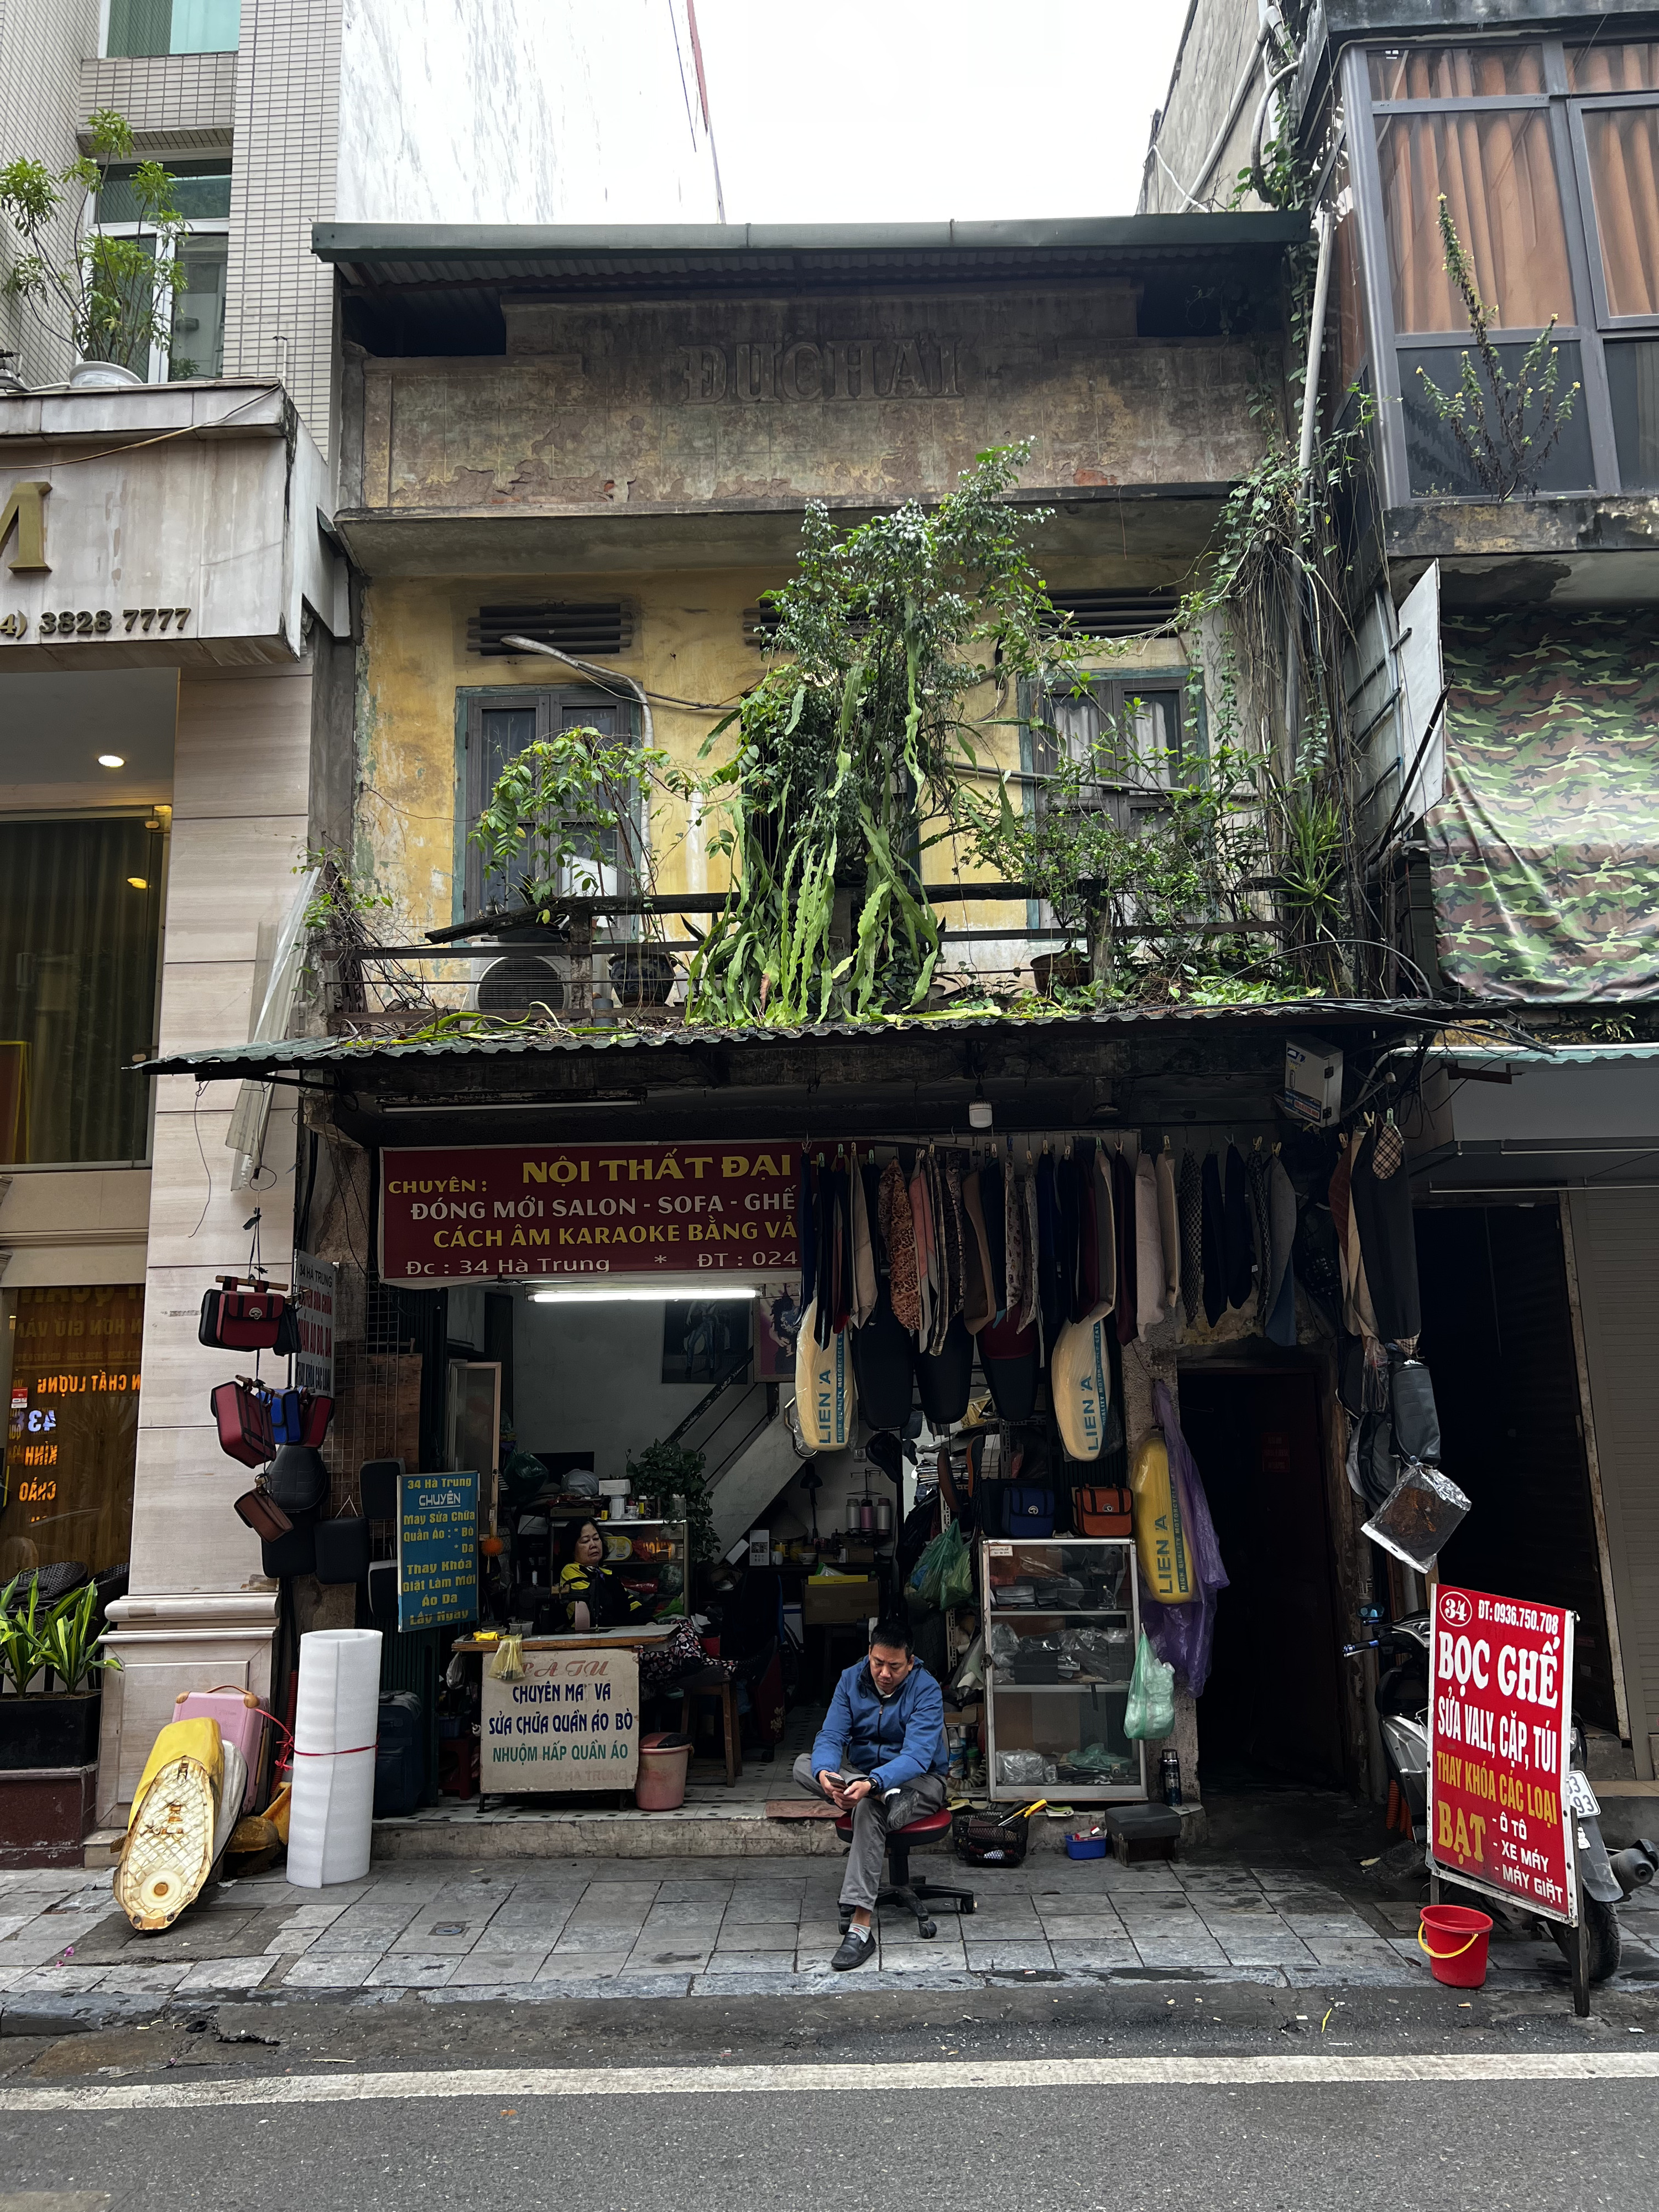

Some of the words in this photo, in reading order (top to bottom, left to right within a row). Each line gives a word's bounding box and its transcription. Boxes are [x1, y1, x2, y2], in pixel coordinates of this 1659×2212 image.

[39, 610, 112, 633] 3828
[122, 608, 191, 632] 7777
[523, 1155, 589, 1187] NỘI
[598, 1148, 713, 1181] THẤT
[721, 1154, 791, 1181] ĐẠI
[388, 1176, 476, 1194] CHUYÊN
[410, 1197, 486, 1220] ĐÓNG
[494, 1195, 544, 1218] MỚI
[552, 1197, 636, 1217] SALON
[658, 1195, 724, 1214] SOFA
[744, 1185, 797, 1211] GHẾ
[434, 1225, 502, 1248] CÁCH
[510, 1224, 550, 1246] ÂM
[559, 1224, 680, 1245] KARAOKE
[688, 1215, 758, 1241] BẰNG
[764, 1215, 797, 1239] VẢ
[300, 1264, 305, 1276] 34
[315, 1270, 332, 1288] TRUNG
[460, 1260, 489, 1274] 34
[499, 1259, 528, 1273] Hà
[536, 1258, 609, 1272] Trung
[697, 1253, 728, 1267] ĐT
[752, 1251, 797, 1266] 024
[819, 1393, 831, 1444] LIEN
[1083, 1400, 1099, 1451] LIEN
[408, 1480, 421, 1489] 34
[425, 1478, 437, 1488] Hà
[441, 1478, 472, 1488] Trung
[419, 1490, 461, 1506] CHUYÊN
[404, 1515, 426, 1525] May
[430, 1511, 448, 1523] Sửa
[451, 1510, 475, 1521] Chữa
[404, 1528, 429, 1542] Quần
[432, 1527, 445, 1540] Áo
[461, 1526, 474, 1537] Bò
[462, 1543, 474, 1553] Da
[1176, 1538, 1185, 1568] QUALITY
[407, 1563, 437, 1575] Thay
[442, 1558, 472, 1571] Khóa
[1156, 1540, 1173, 1594] LIEN
[429, 1578, 451, 1589] Làm
[456, 1574, 476, 1587] Mới
[422, 1594, 437, 1607] Áo
[442, 1594, 457, 1604] Da
[1444, 1598, 1467, 1621] 34
[1494, 1602, 1559, 1635] 0936.750.708
[1438, 1631, 1490, 1697] BỌC
[1498, 1636, 1561, 1709] GHẾ
[513, 1681, 560, 1704] CHUYÊN
[489, 1710, 512, 1736] SỬA
[516, 1712, 549, 1735] CHỮA
[552, 1709, 587, 1734] QUẦN
[591, 1709, 609, 1733] ÁO
[615, 1708, 633, 1730] BÒ
[1438, 1686, 1461, 1741] SỬA
[1464, 1704, 1495, 1759] VALY,
[1499, 1710, 1529, 1771] CẶP,
[1533, 1720, 1557, 1774] TÚI
[493, 1743, 538, 1765] NHUỘM
[542, 1740, 567, 1761] HẤP
[571, 1739, 606, 1760] QUẦN
[611, 1740, 628, 1759] ÁO
[1437, 1750, 1462, 1788] THAY
[1465, 1761, 1496, 1802] KHÓA
[1499, 1770, 1524, 1812] CÁC
[1527, 1783, 1558, 1828] LOẠI
[1569, 1776, 1580, 1793] 3
[1573, 1794, 1594, 1814] 93
[1438, 1800, 1486, 1865] BẠT
[1500, 1811, 1508, 1833] Ô
[1511, 1818, 1527, 1840] TÔ
[1501, 1839, 1517, 1861] XE
[1521, 1849, 1549, 1873] MÁY
[1503, 1865, 1530, 1890] MÁY
[1534, 1877, 1563, 1904] GIẶT
